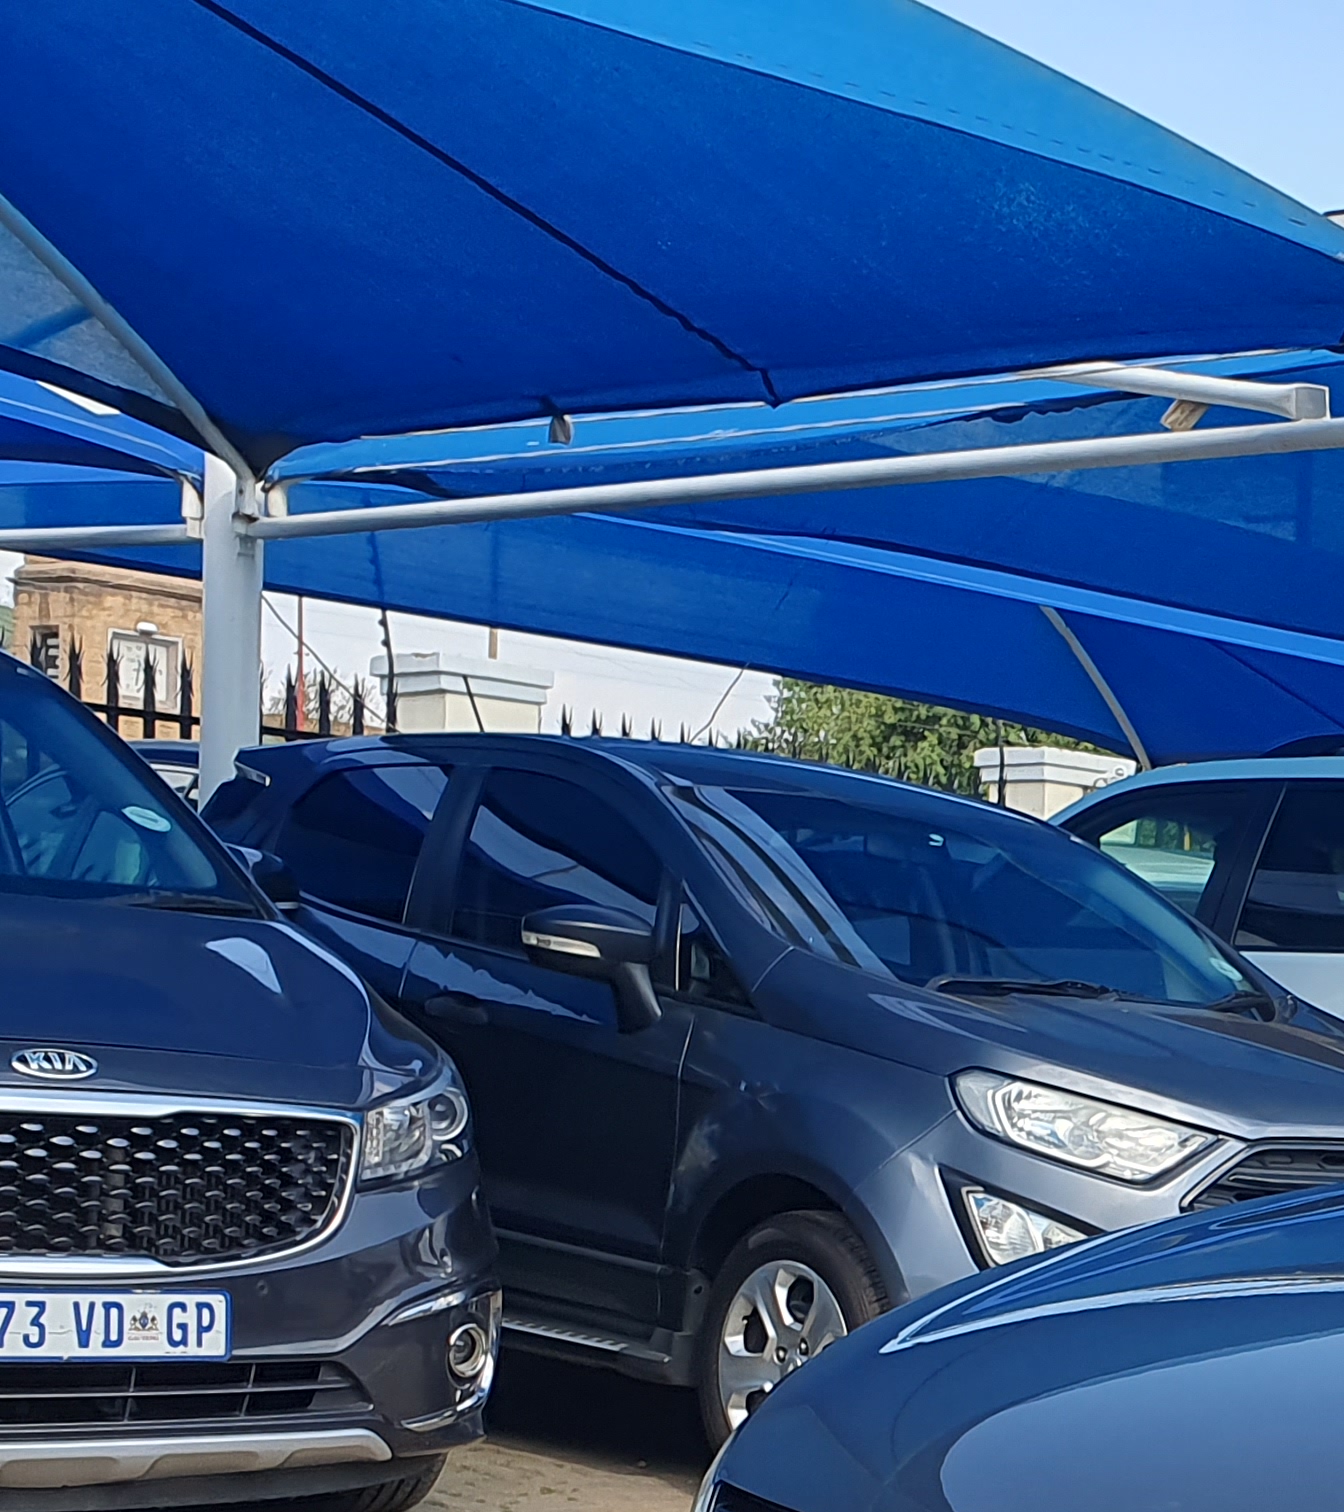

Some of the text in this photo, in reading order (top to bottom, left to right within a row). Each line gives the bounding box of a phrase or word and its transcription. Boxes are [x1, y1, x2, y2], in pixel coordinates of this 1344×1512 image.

[24, 1051, 87, 1071] KIA
[73, 1301, 125, 1349] VD
[166, 1301, 216, 1349] GP
